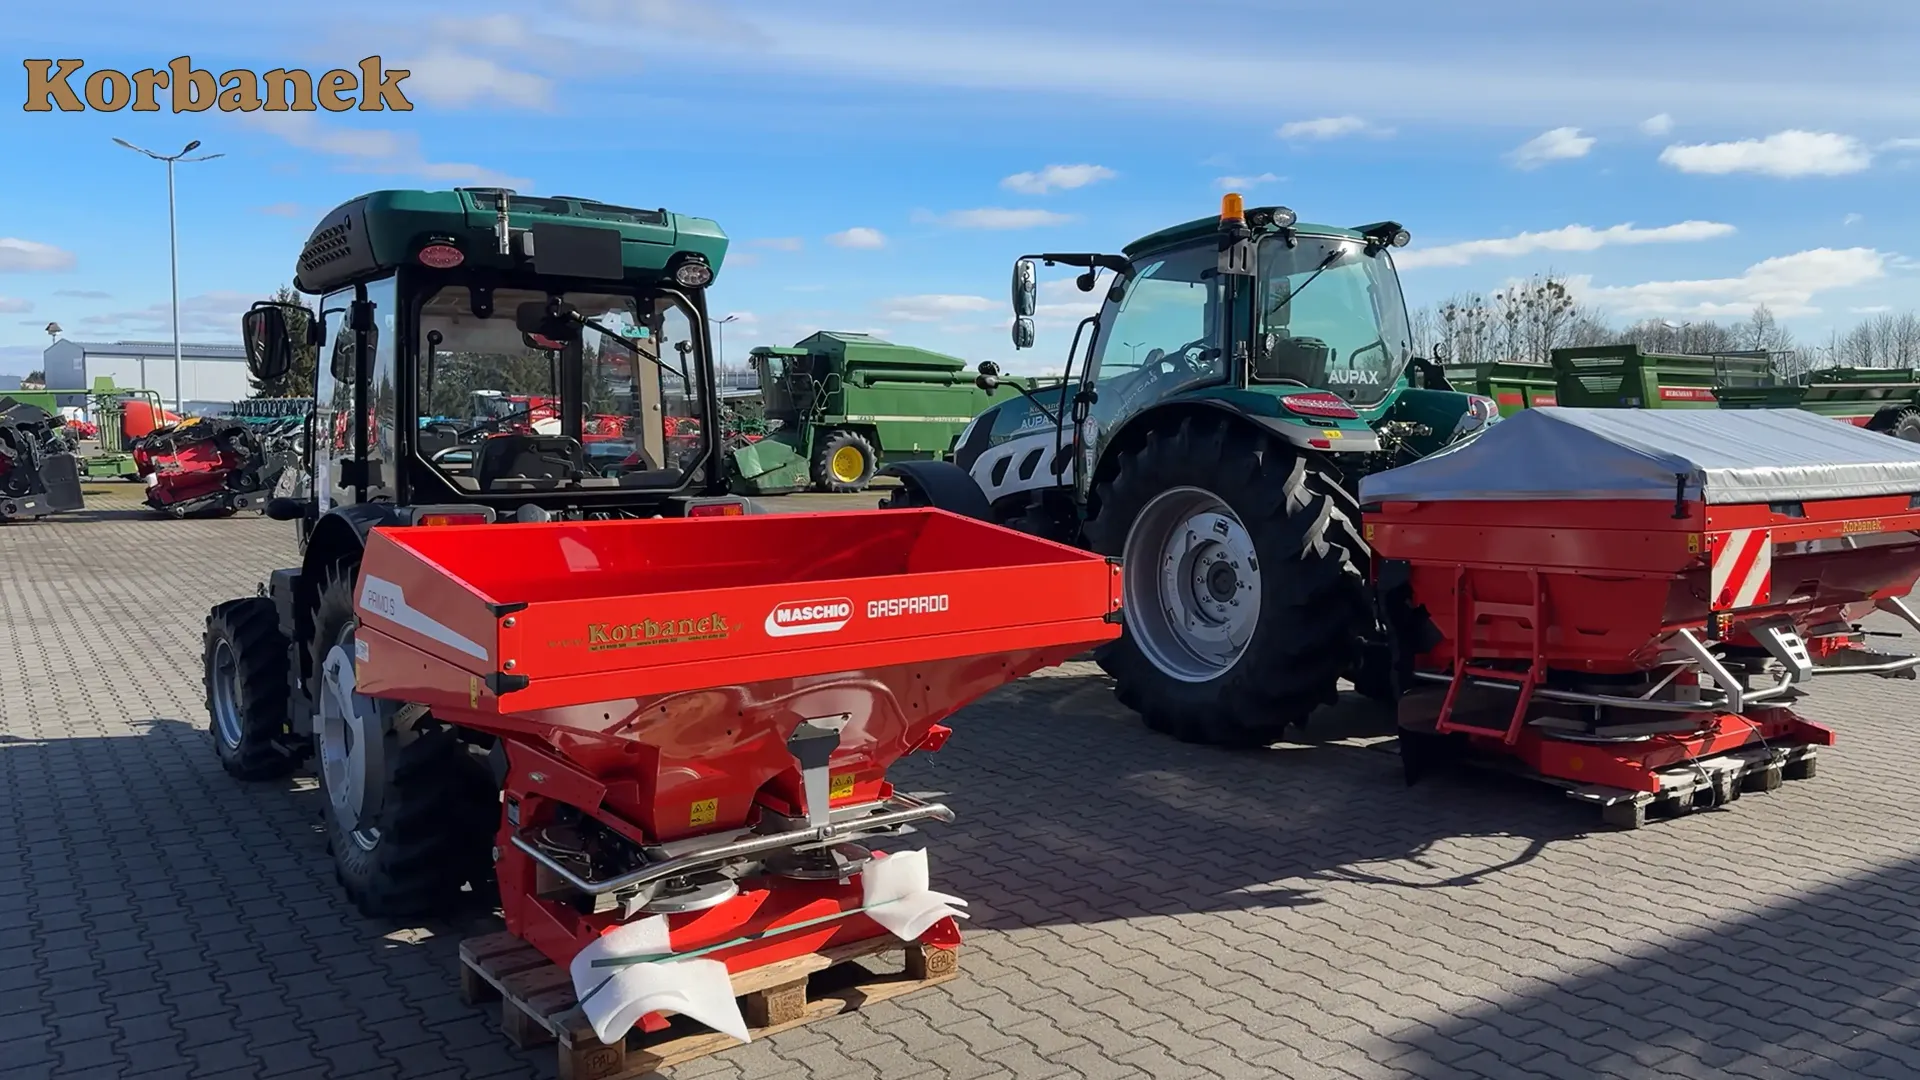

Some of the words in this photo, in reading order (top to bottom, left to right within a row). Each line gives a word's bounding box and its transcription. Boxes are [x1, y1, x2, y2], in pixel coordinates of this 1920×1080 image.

[1327, 369, 1379, 385] AUPAX
[1842, 518, 1882, 532] Korbanek
[777, 603, 850, 623] MASCHIO
[867, 594, 949, 619] GASPARDO
[588, 612, 729, 645] Korbanek
